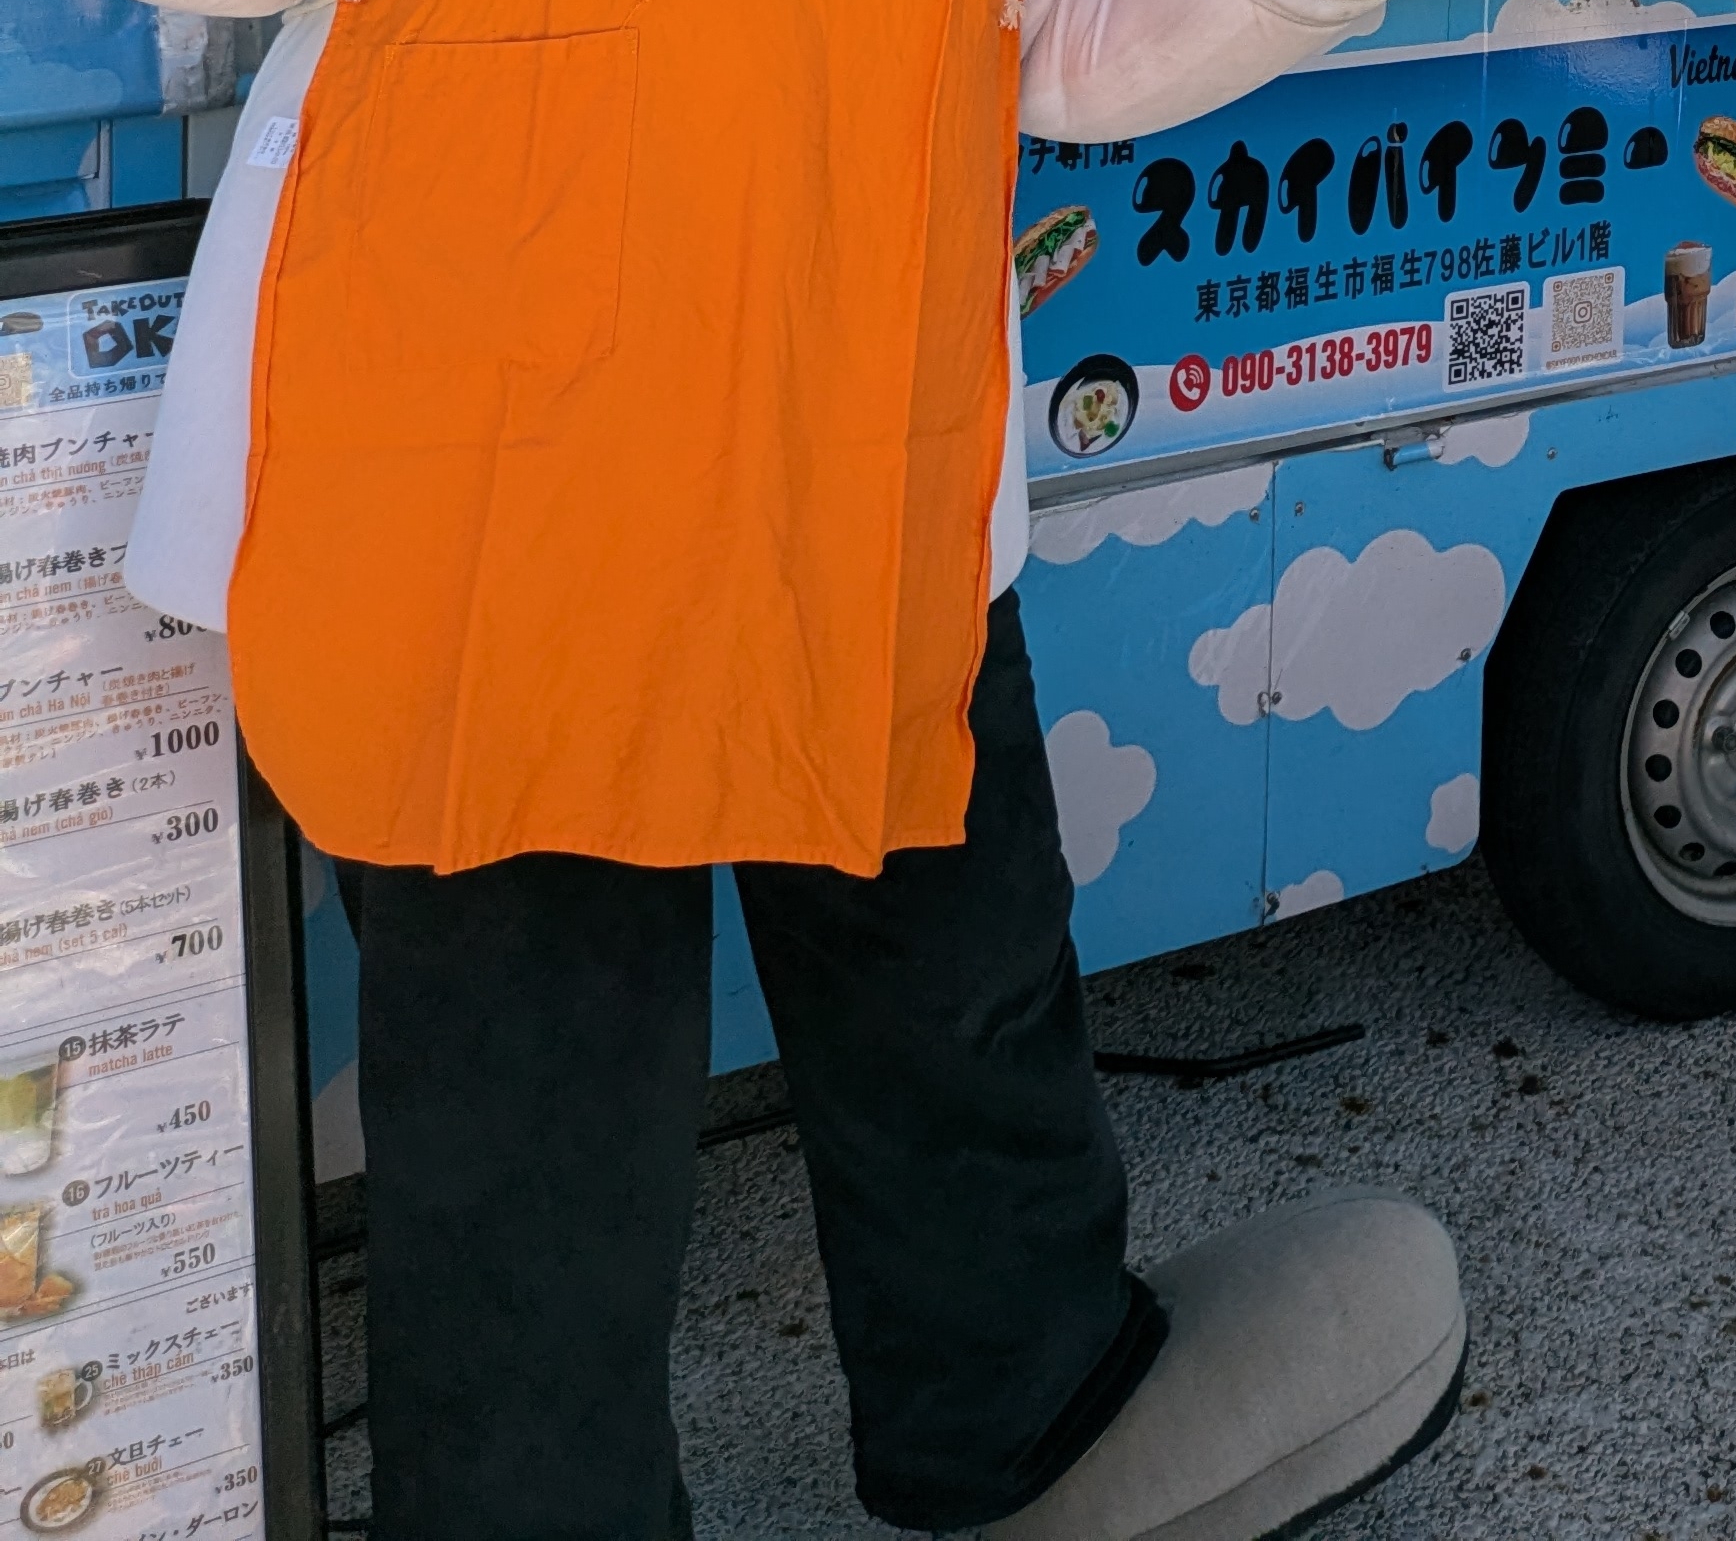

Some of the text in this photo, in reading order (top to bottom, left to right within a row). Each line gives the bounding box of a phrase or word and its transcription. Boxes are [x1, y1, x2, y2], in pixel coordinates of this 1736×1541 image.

[1018, 137, 1136, 175] チ専門店
[1132, 106, 1669, 267] スカイバインミー
[1194, 220, 1612, 322] 東京都福生市福生798佐藤ビル1階
[1222, 324, 1433, 399] 090-3138-3979
[134, 720, 221, 760] ¥1000
[151, 807, 220, 845] ¥300
[155, 925, 224, 964] ¥700
[88, 1013, 186, 1058] 抹茶ラテ
[88, 1044, 174, 1077] matcha latte
[156, 1100, 212, 1133] ¥450
[94, 1145, 245, 1200] フルーツティー
[114, 1198, 137, 1214] hoa
[161, 1242, 217, 1278] ¥550
[186, 1281, 254, 1314] ございます
[106, 1320, 240, 1370] ミックスチェー
[210, 1355, 255, 1384] ¥350
[107, 1427, 205, 1471] 文旦チェー
[215, 1465, 258, 1495] ¥350
